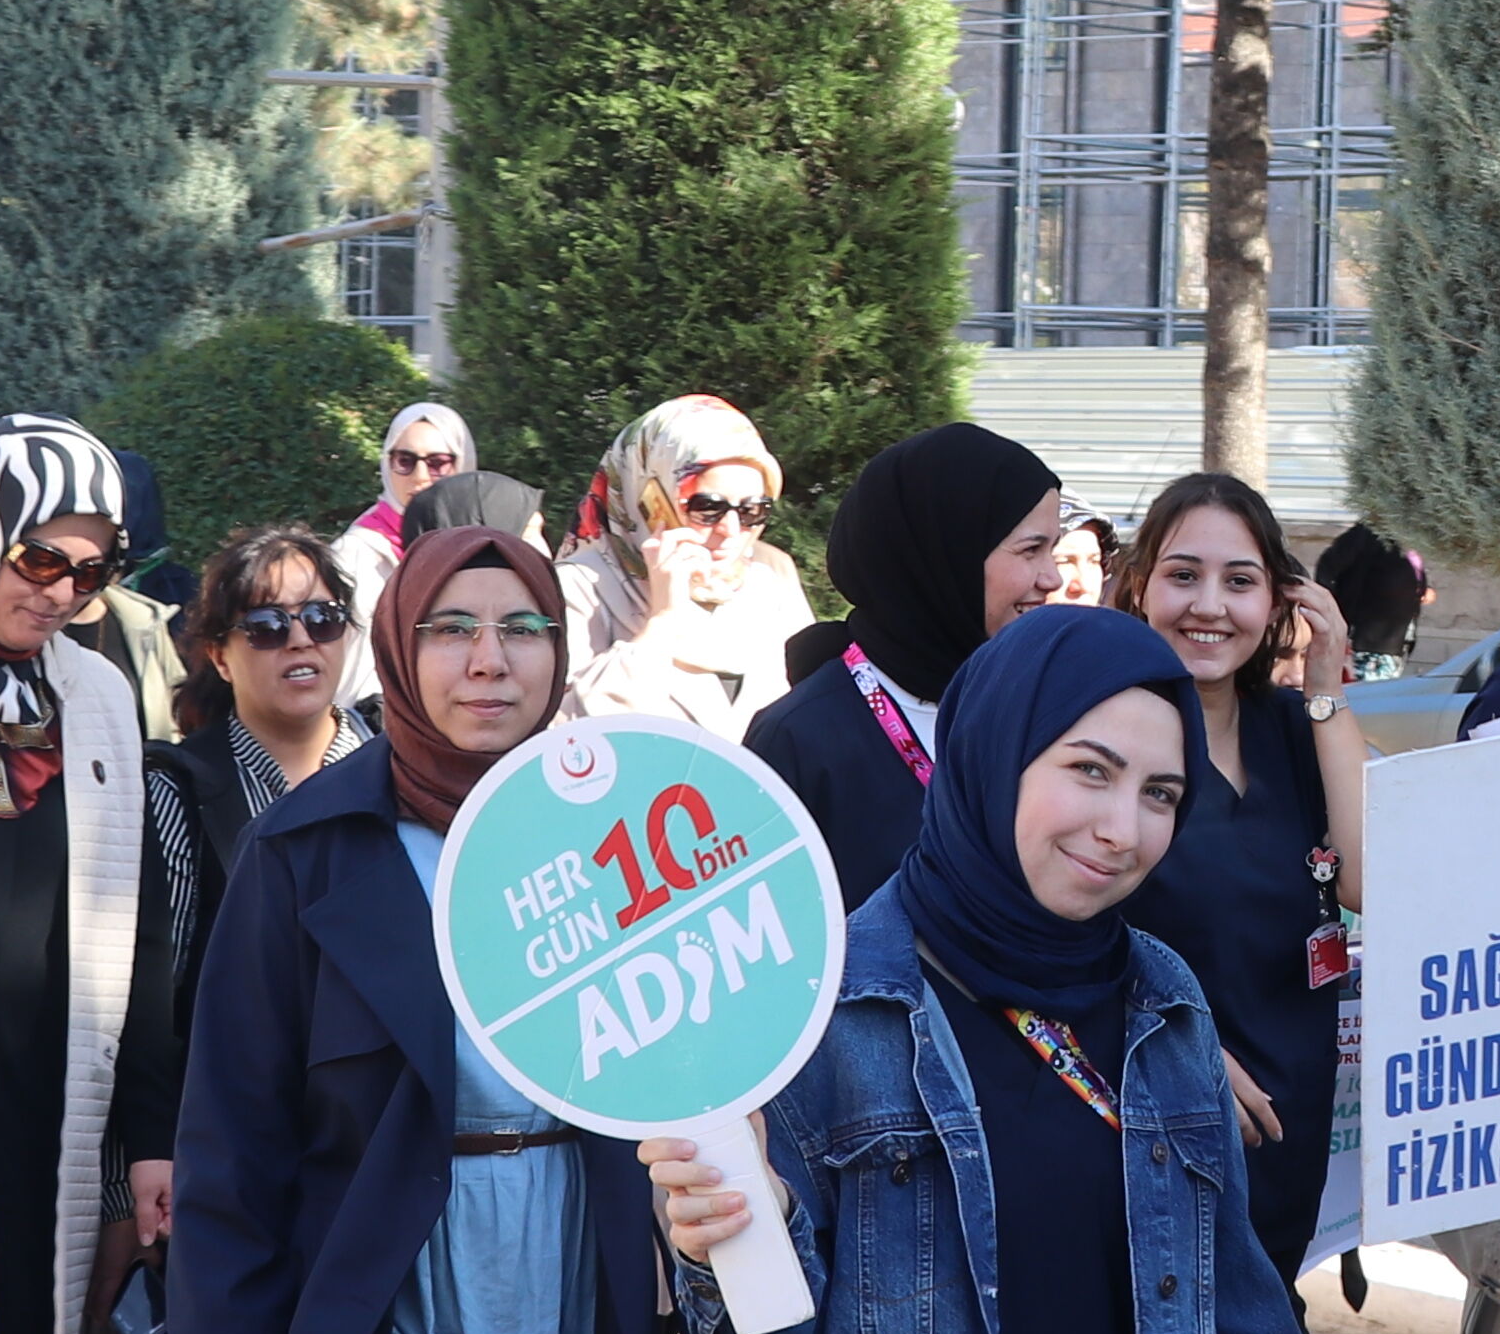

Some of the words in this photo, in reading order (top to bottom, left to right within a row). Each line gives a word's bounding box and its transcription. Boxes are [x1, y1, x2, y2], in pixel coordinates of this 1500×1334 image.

[504, 850, 593, 930] HER
[593, 783, 716, 929] 10
[694, 833, 748, 881] bin
[526, 900, 609, 978] GÜN
